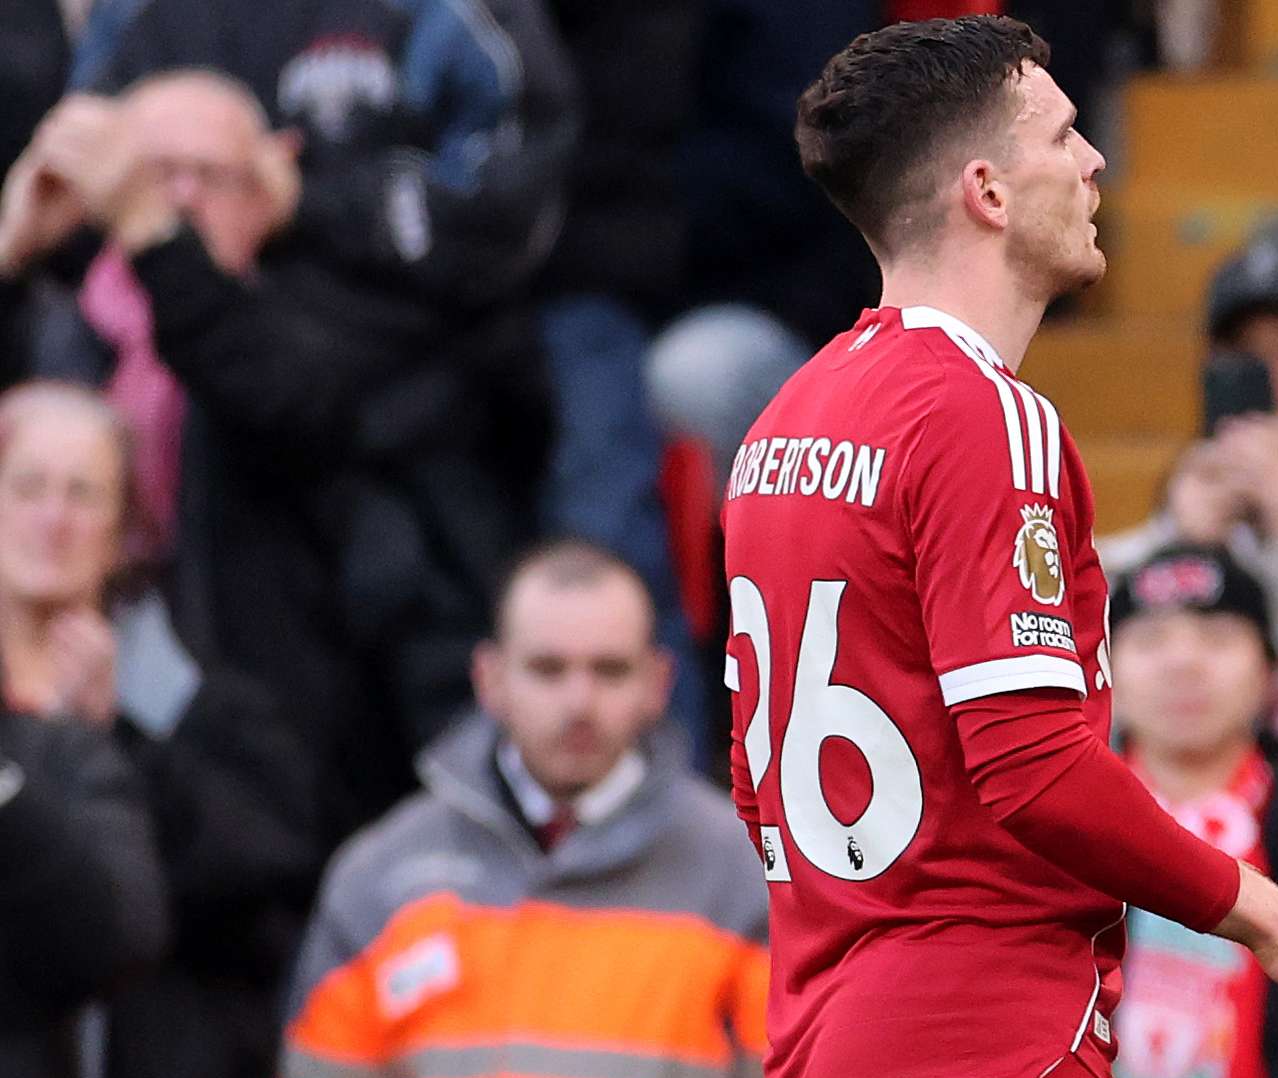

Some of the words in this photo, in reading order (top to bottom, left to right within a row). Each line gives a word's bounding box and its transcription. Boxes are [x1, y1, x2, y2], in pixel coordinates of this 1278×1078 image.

[728, 437, 886, 507] ROBERTSON
[1010, 612, 1038, 631] No
[1038, 616, 1071, 638] room
[723, 575, 924, 881] 26
